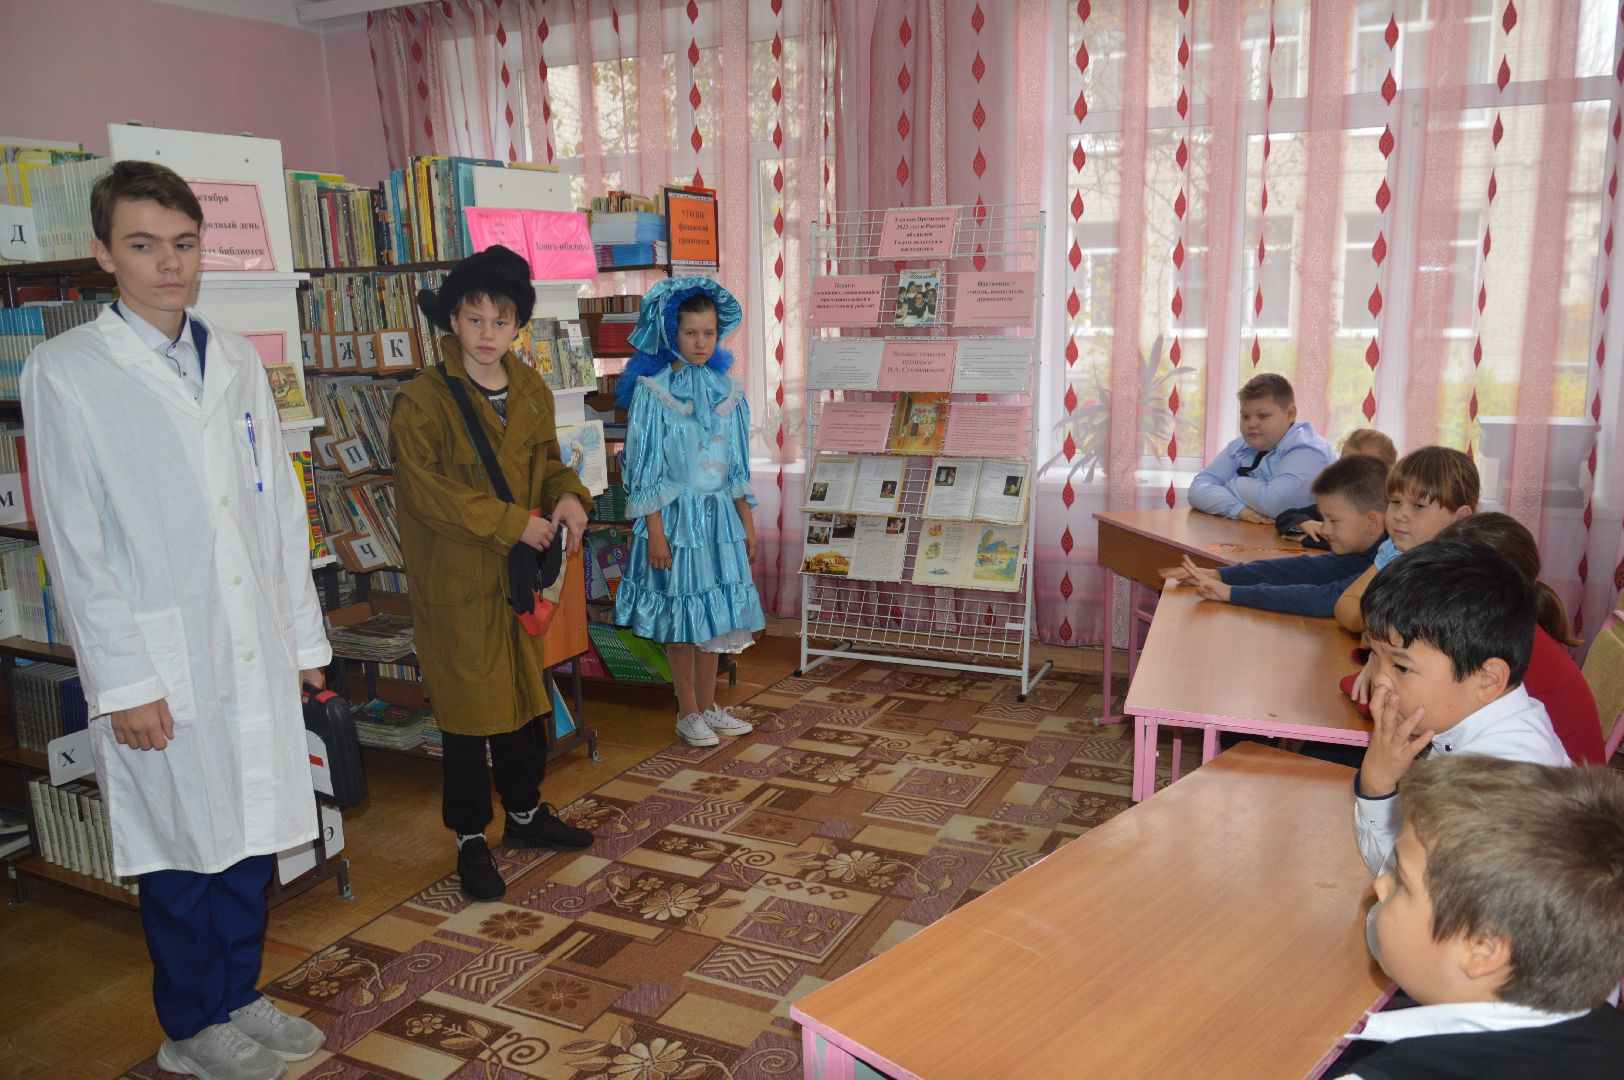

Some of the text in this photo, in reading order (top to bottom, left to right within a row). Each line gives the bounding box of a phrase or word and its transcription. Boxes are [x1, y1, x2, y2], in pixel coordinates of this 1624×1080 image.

[196, 192, 229, 205] ктября
[11, 224, 26, 246] Д
[219, 246, 264, 257] библиотек
[340, 341, 356, 360] Ж
[390, 338, 404, 358] К
[344, 445, 365, 464] П
[360, 542, 377, 559] Ч
